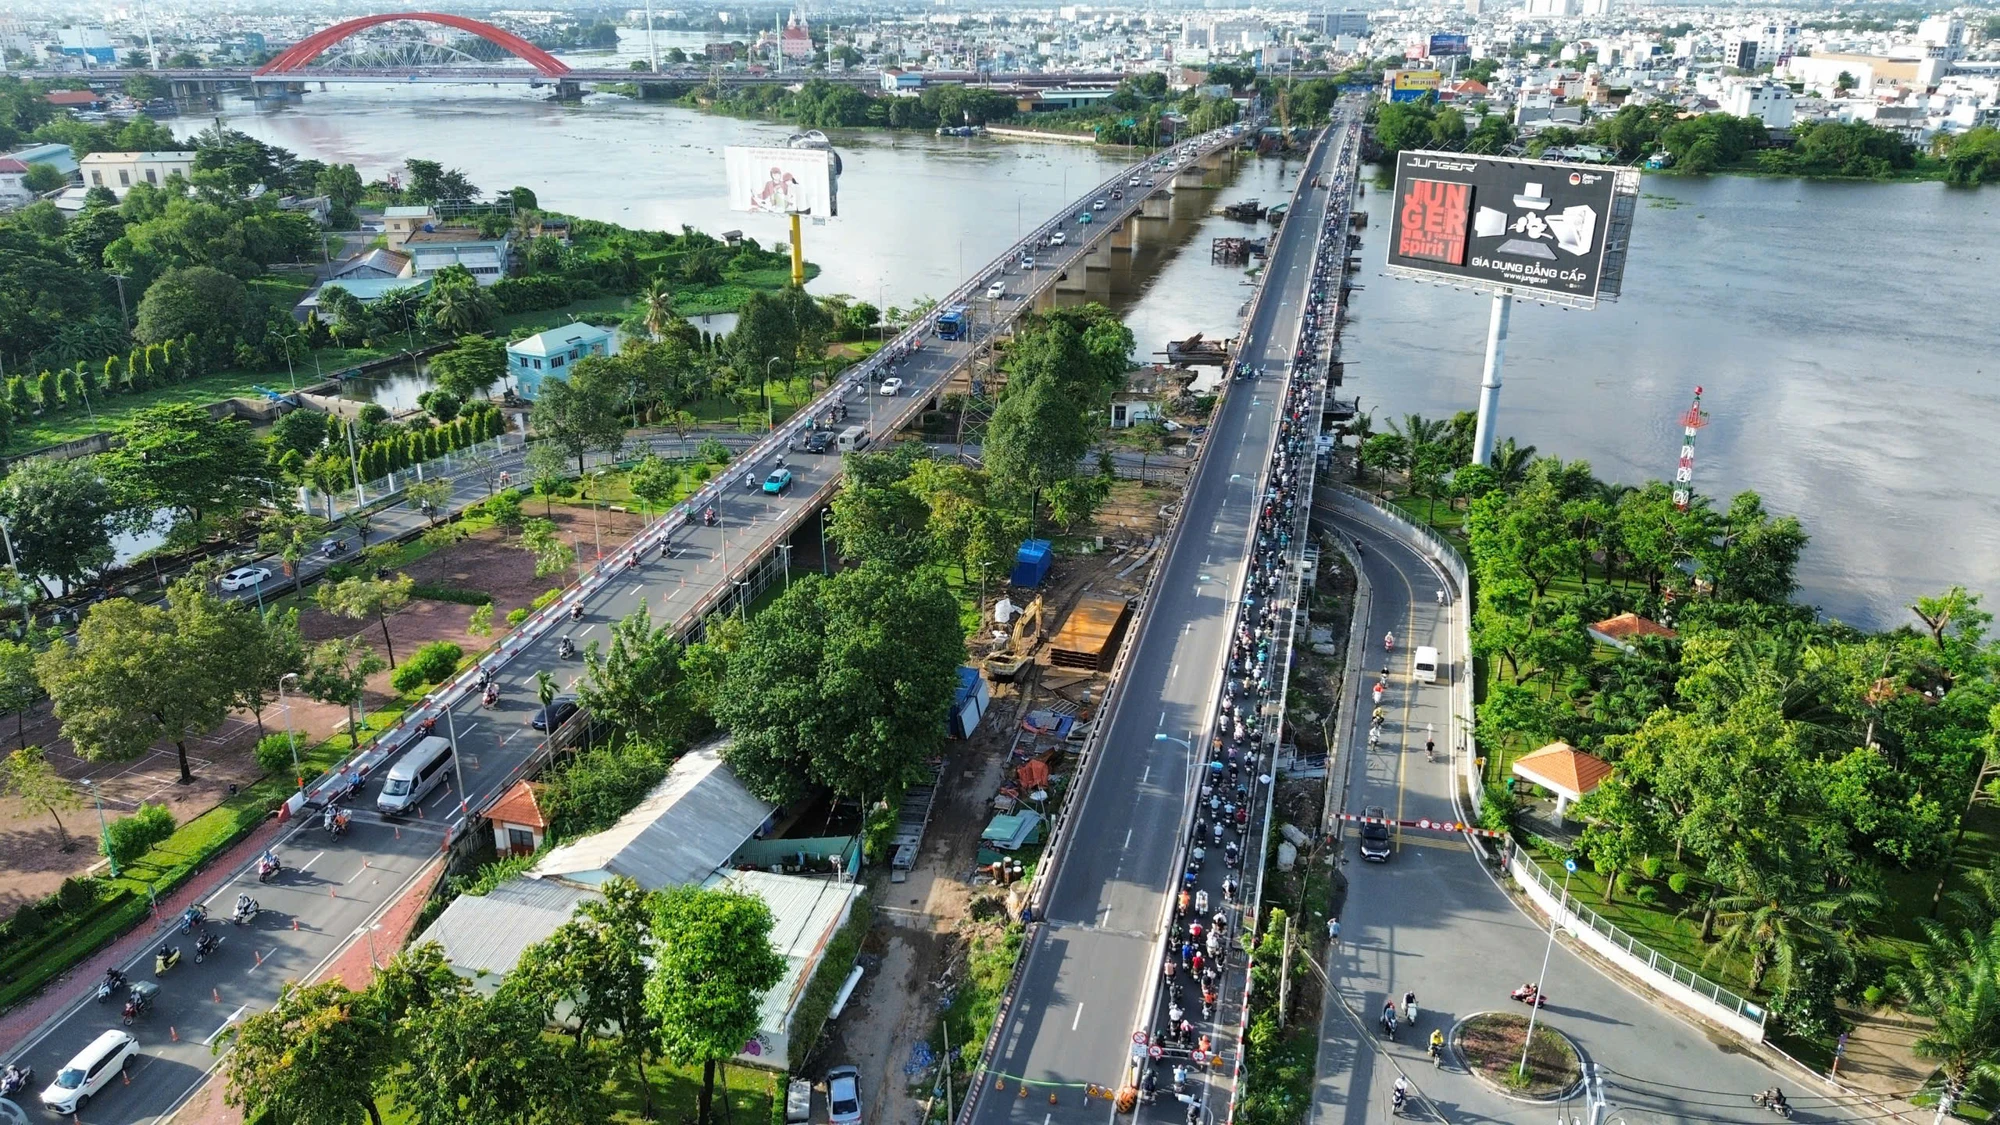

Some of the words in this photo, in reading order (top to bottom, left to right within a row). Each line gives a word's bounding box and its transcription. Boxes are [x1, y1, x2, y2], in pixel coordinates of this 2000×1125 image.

[1406, 157, 1477, 173] JUNGER
[1404, 180, 1467, 209] JUN
[1401, 203, 1467, 236] GER
[1399, 236, 1445, 257] spirit
[1491, 260, 1523, 273] DỤNG
[1524, 262, 1558, 278] ĐẲNG
[1559, 268, 1587, 282] CẤP
[1503, 272, 1548, 285] www.junger.vn
